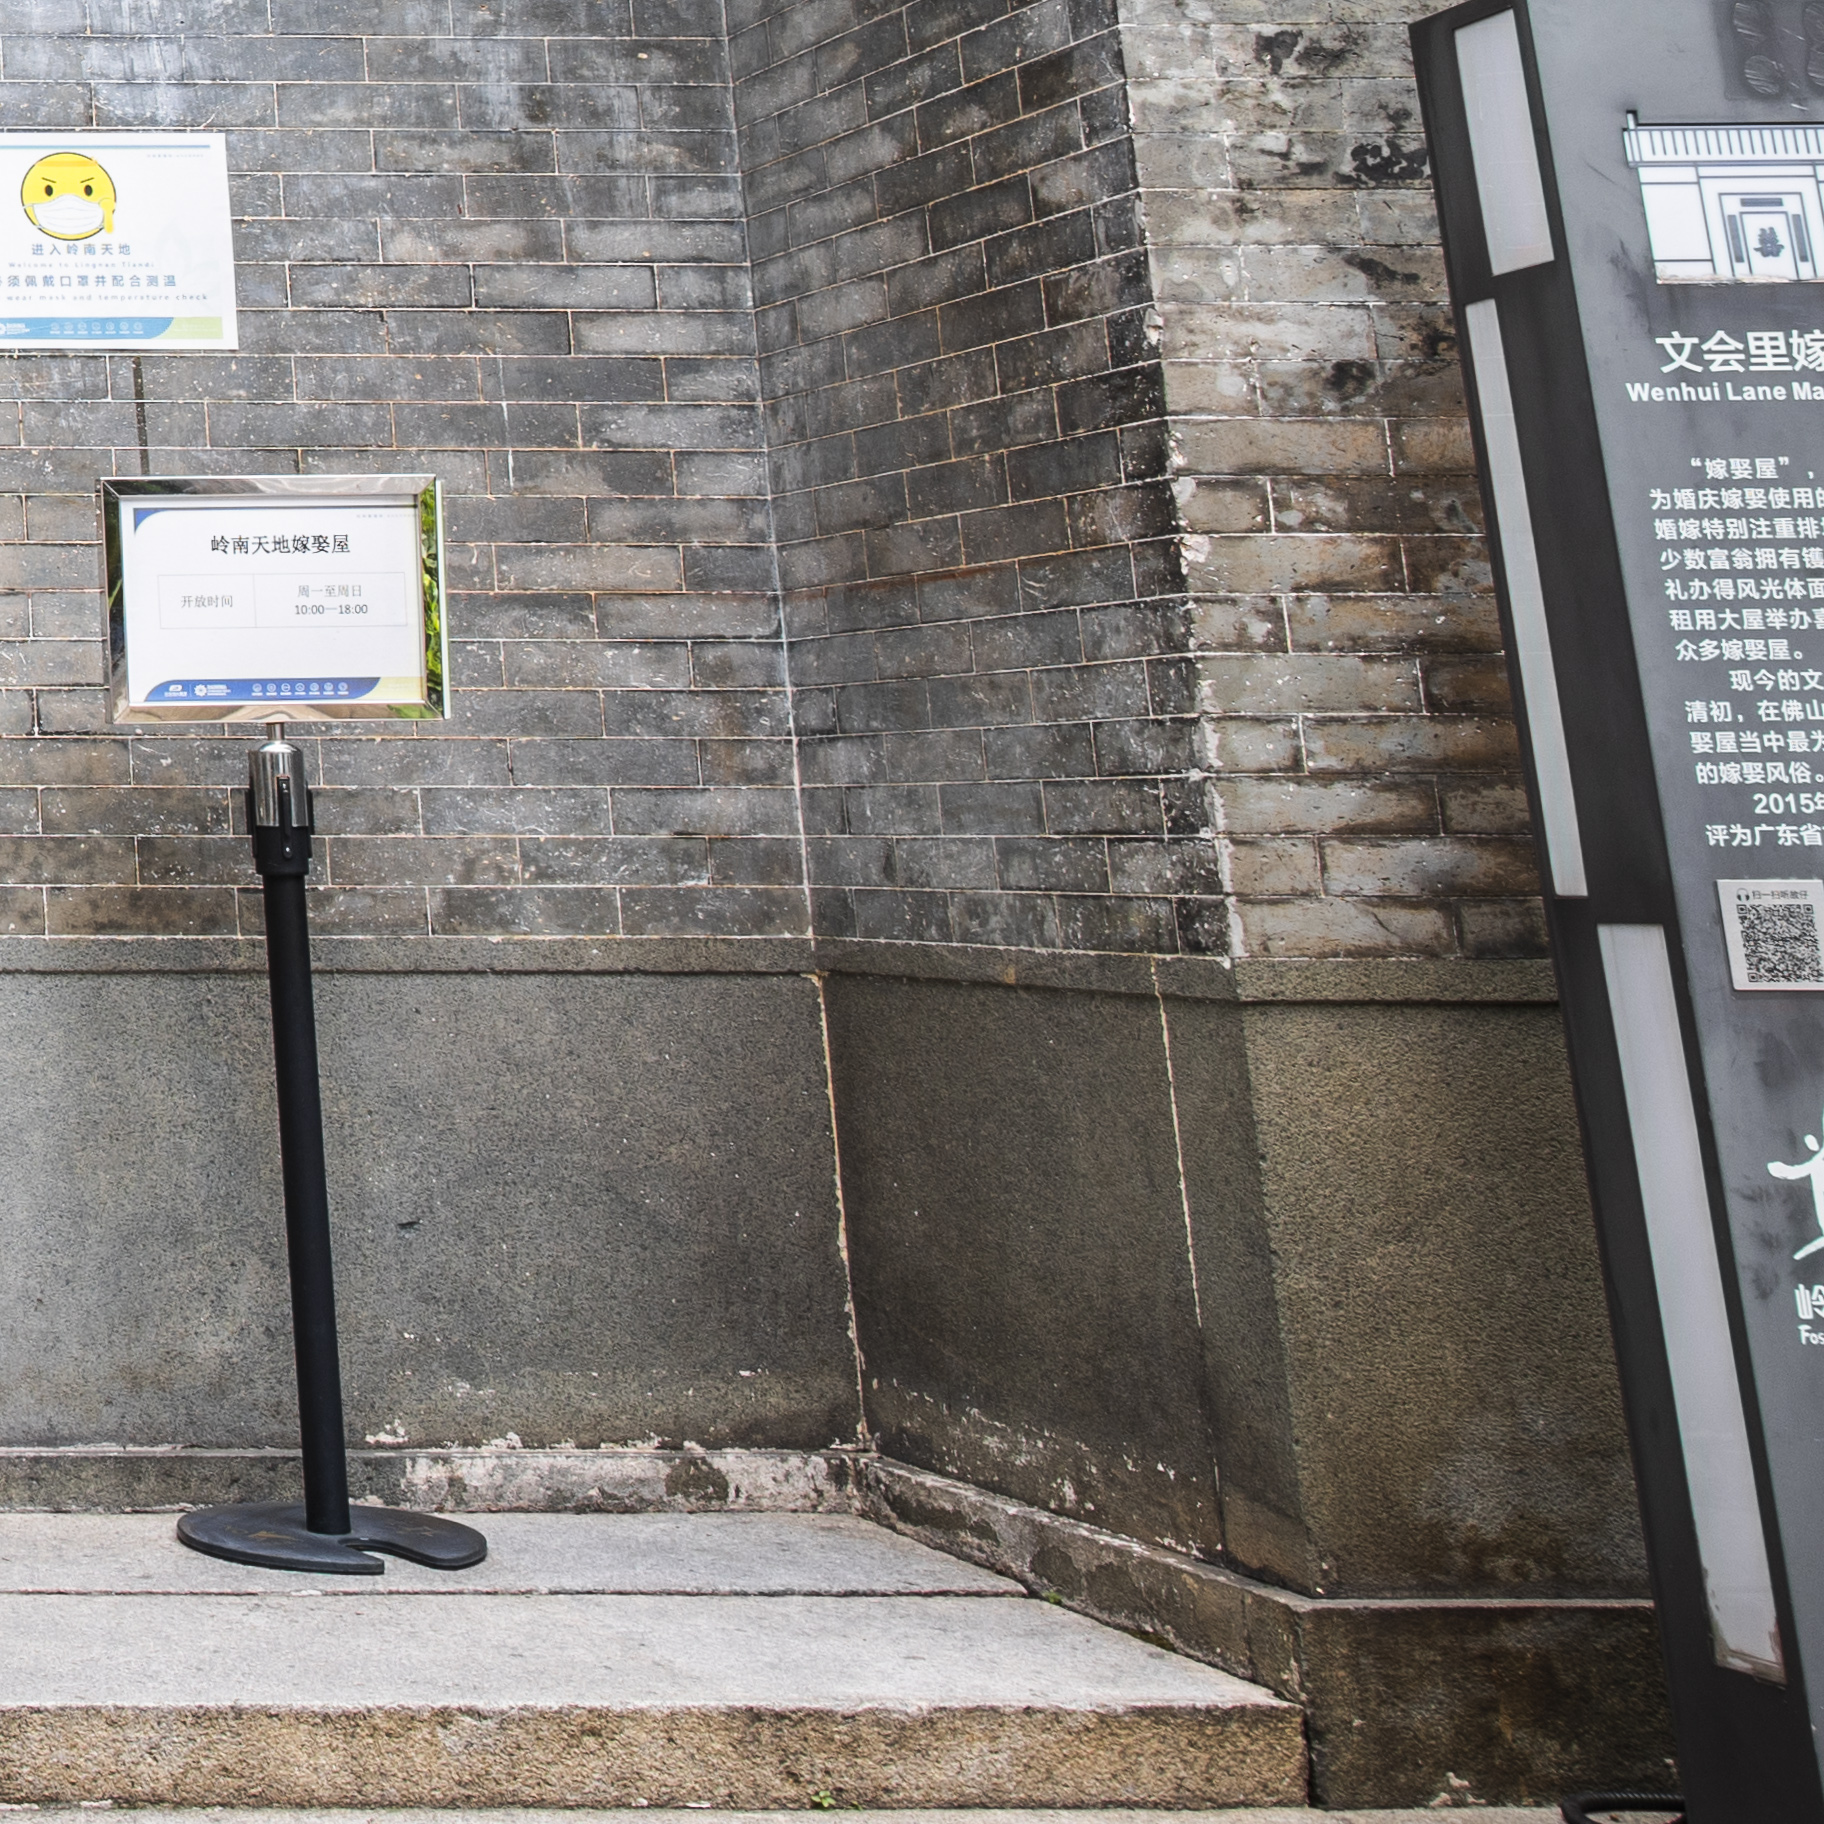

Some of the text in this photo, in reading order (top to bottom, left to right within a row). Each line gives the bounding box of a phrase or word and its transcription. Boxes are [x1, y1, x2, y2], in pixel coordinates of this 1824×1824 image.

[31, 243, 131, 256] 进入岭南天地
[1625, 382, 1721, 402] Wenhui
[1725, 382, 1787, 401] Lane
[1654, 517, 1824, 540] 婚嫁特别注重排
[210, 534, 351, 555] 岭南天地嫁娶屋
[180, 594, 234, 609] 开放时间
[297, 584, 362, 598] 周一至周日
[1675, 639, 1803, 661] 众多嫁娶屋。
[1728, 668, 1824, 691] 现今的文
[1695, 761, 1824, 784] 的嫁娶风俗。
